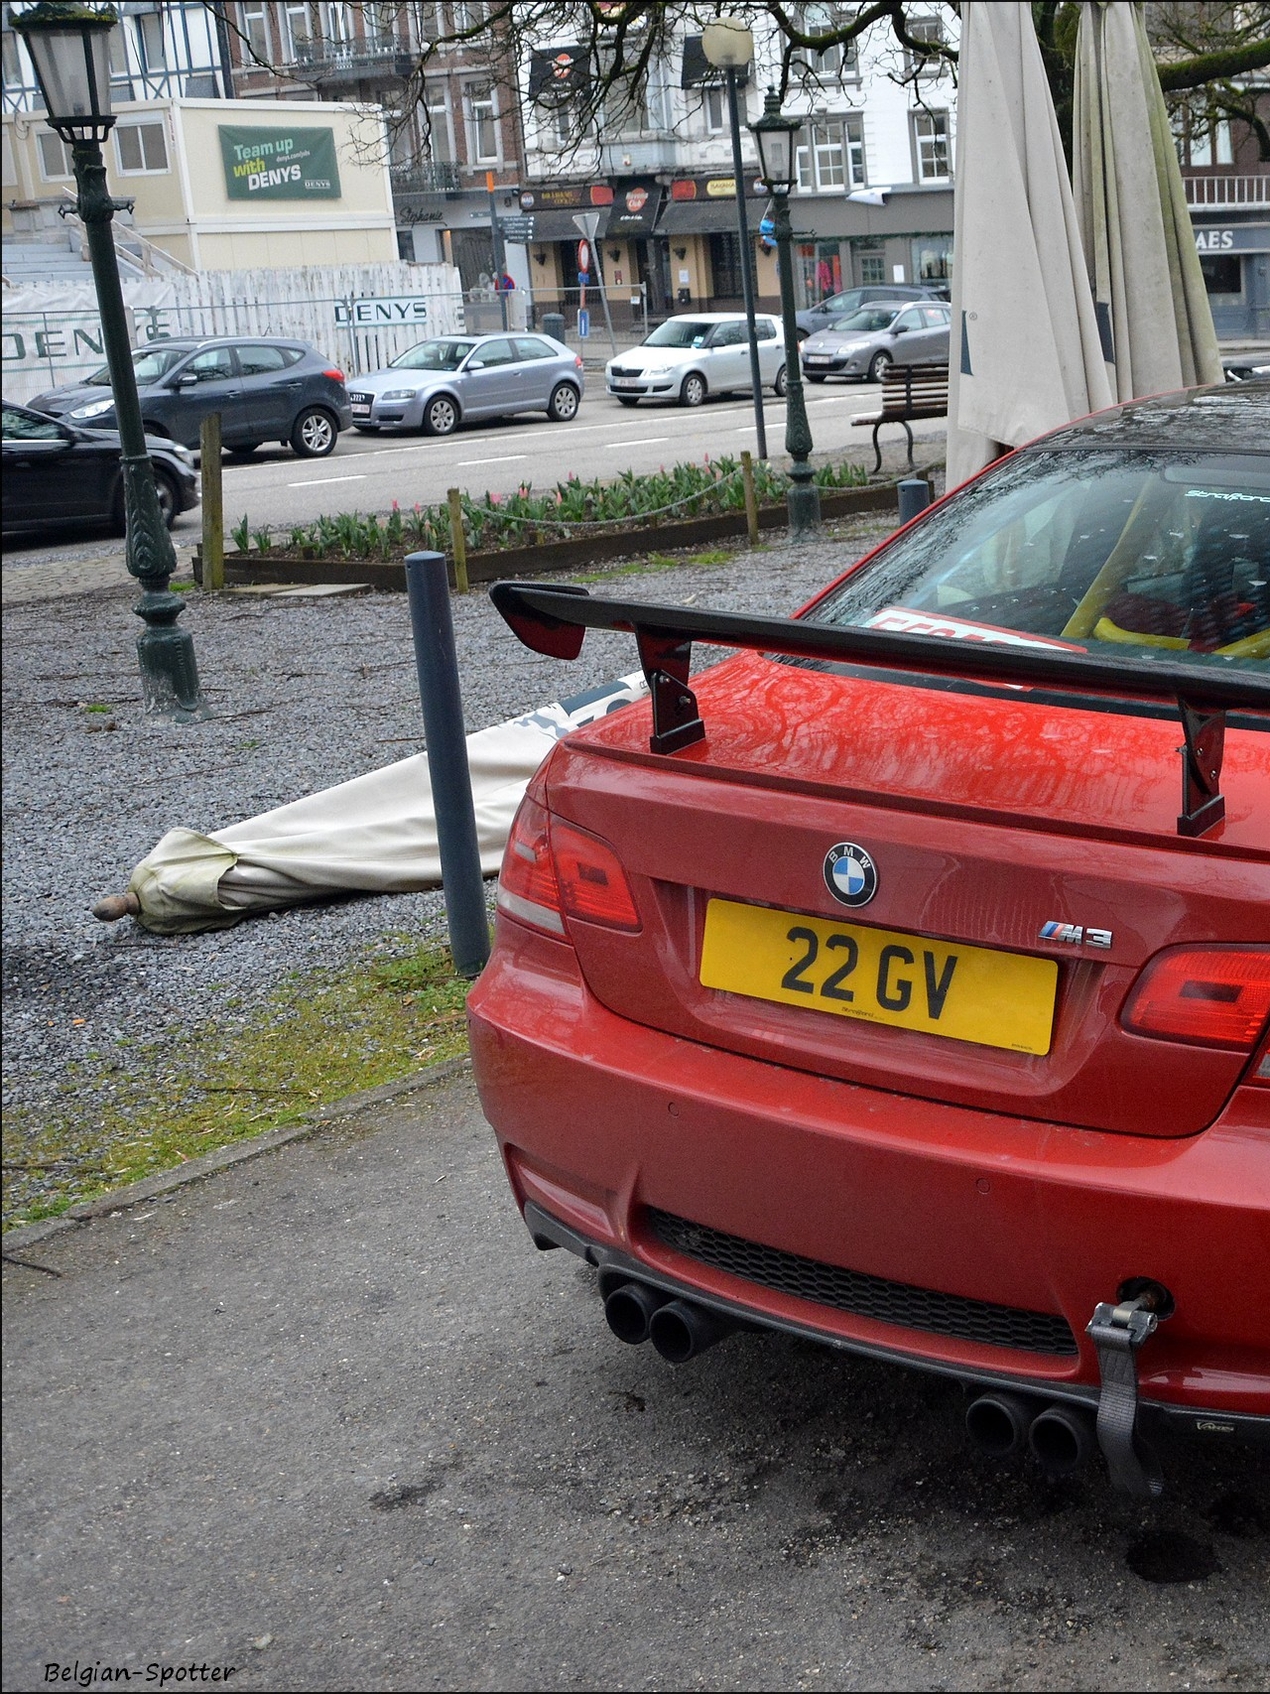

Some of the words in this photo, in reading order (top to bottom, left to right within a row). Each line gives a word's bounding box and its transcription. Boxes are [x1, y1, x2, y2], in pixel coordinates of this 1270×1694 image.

[233, 141, 274, 160] Team
[275, 138, 294, 155] up
[233, 157, 266, 178] with
[248, 164, 302, 191] DENYS
[335, 301, 427, 323] DENYS
[2, 323, 171, 361] DENS
[828, 846, 871, 869] BMW
[1050, 921, 1113, 949] M3
[781, 926, 858, 1003] 22
[876, 944, 959, 1021] GV
